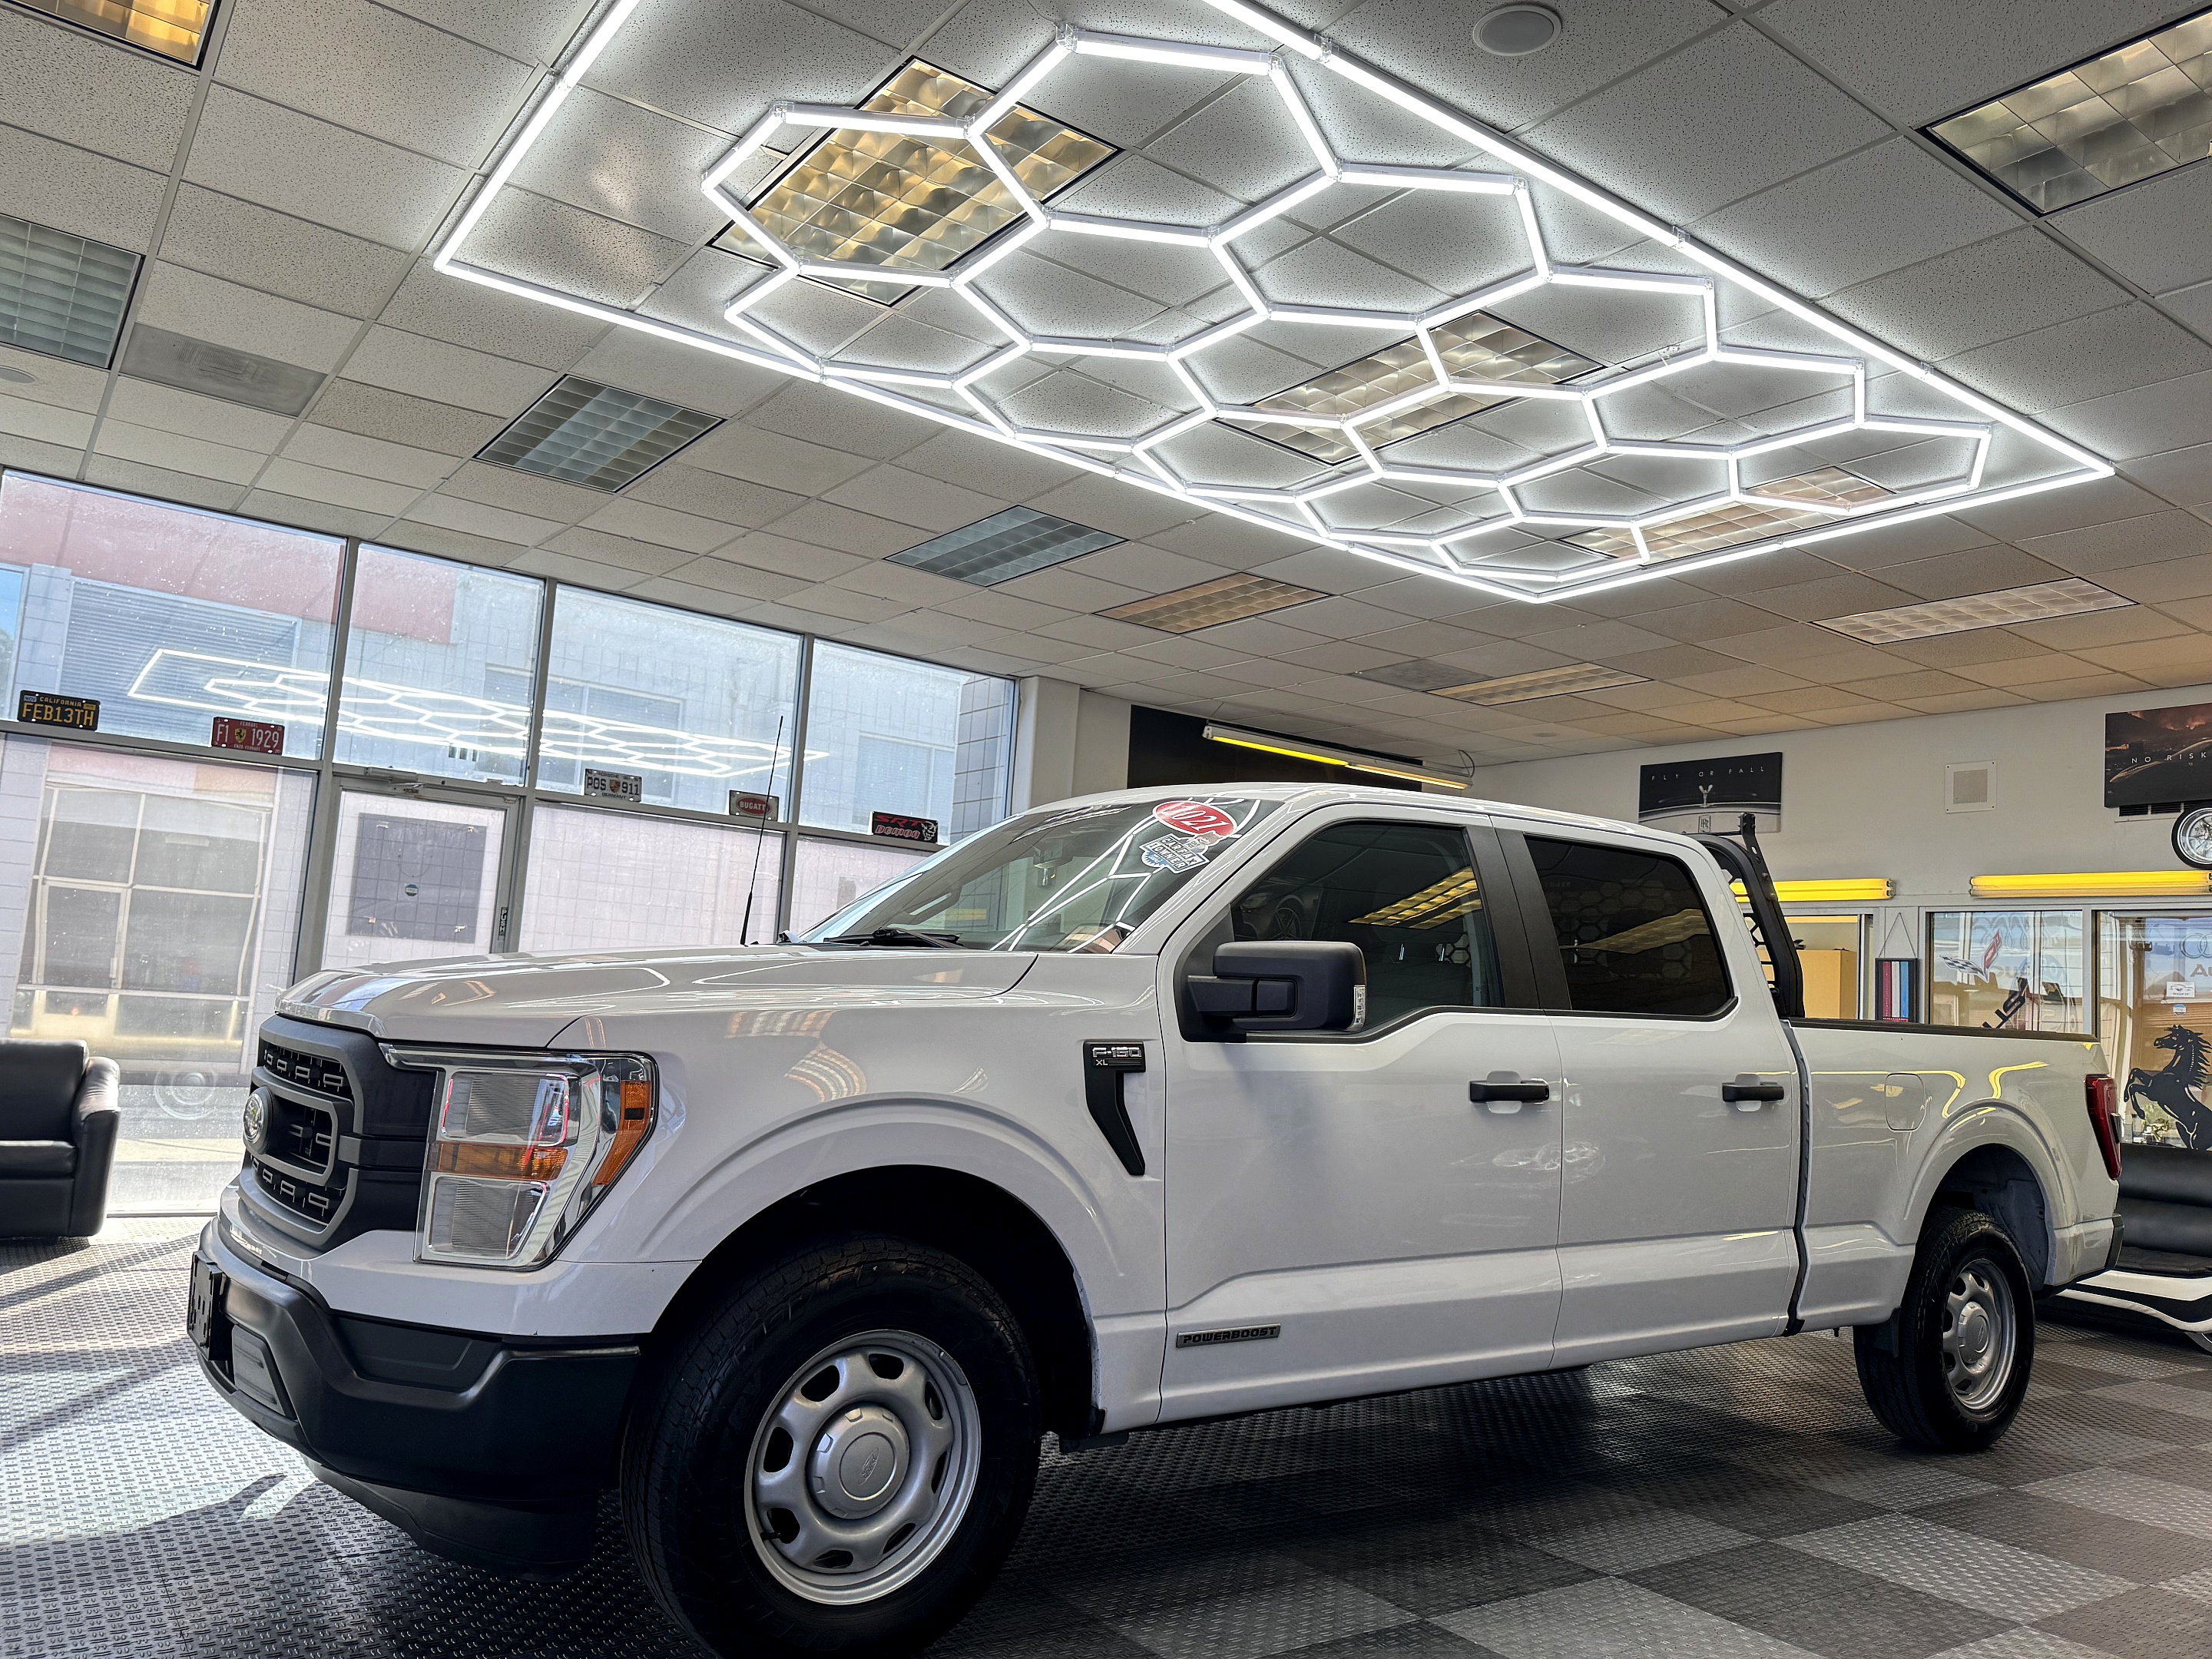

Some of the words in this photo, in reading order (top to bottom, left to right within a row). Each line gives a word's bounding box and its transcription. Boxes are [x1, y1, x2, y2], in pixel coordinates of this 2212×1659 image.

[39, 697, 81, 707] CALIFORNIA
[22, 702, 94, 726] FEB13TH
[217, 724, 229, 743] F1
[251, 728, 280, 748] 1929
[2167, 752, 2207, 761] RISK
[587, 777, 607, 791] POS
[621, 781, 640, 796] 911
[740, 801, 767, 811] BUGATT
[874, 815, 925, 827] SRT
[1161, 837, 1197, 864] CARFAX
[499, 909, 508, 932] PUSH
[1092, 1046, 1142, 1058] F-150
[1182, 1326, 1277, 1343] POWERBOOST
